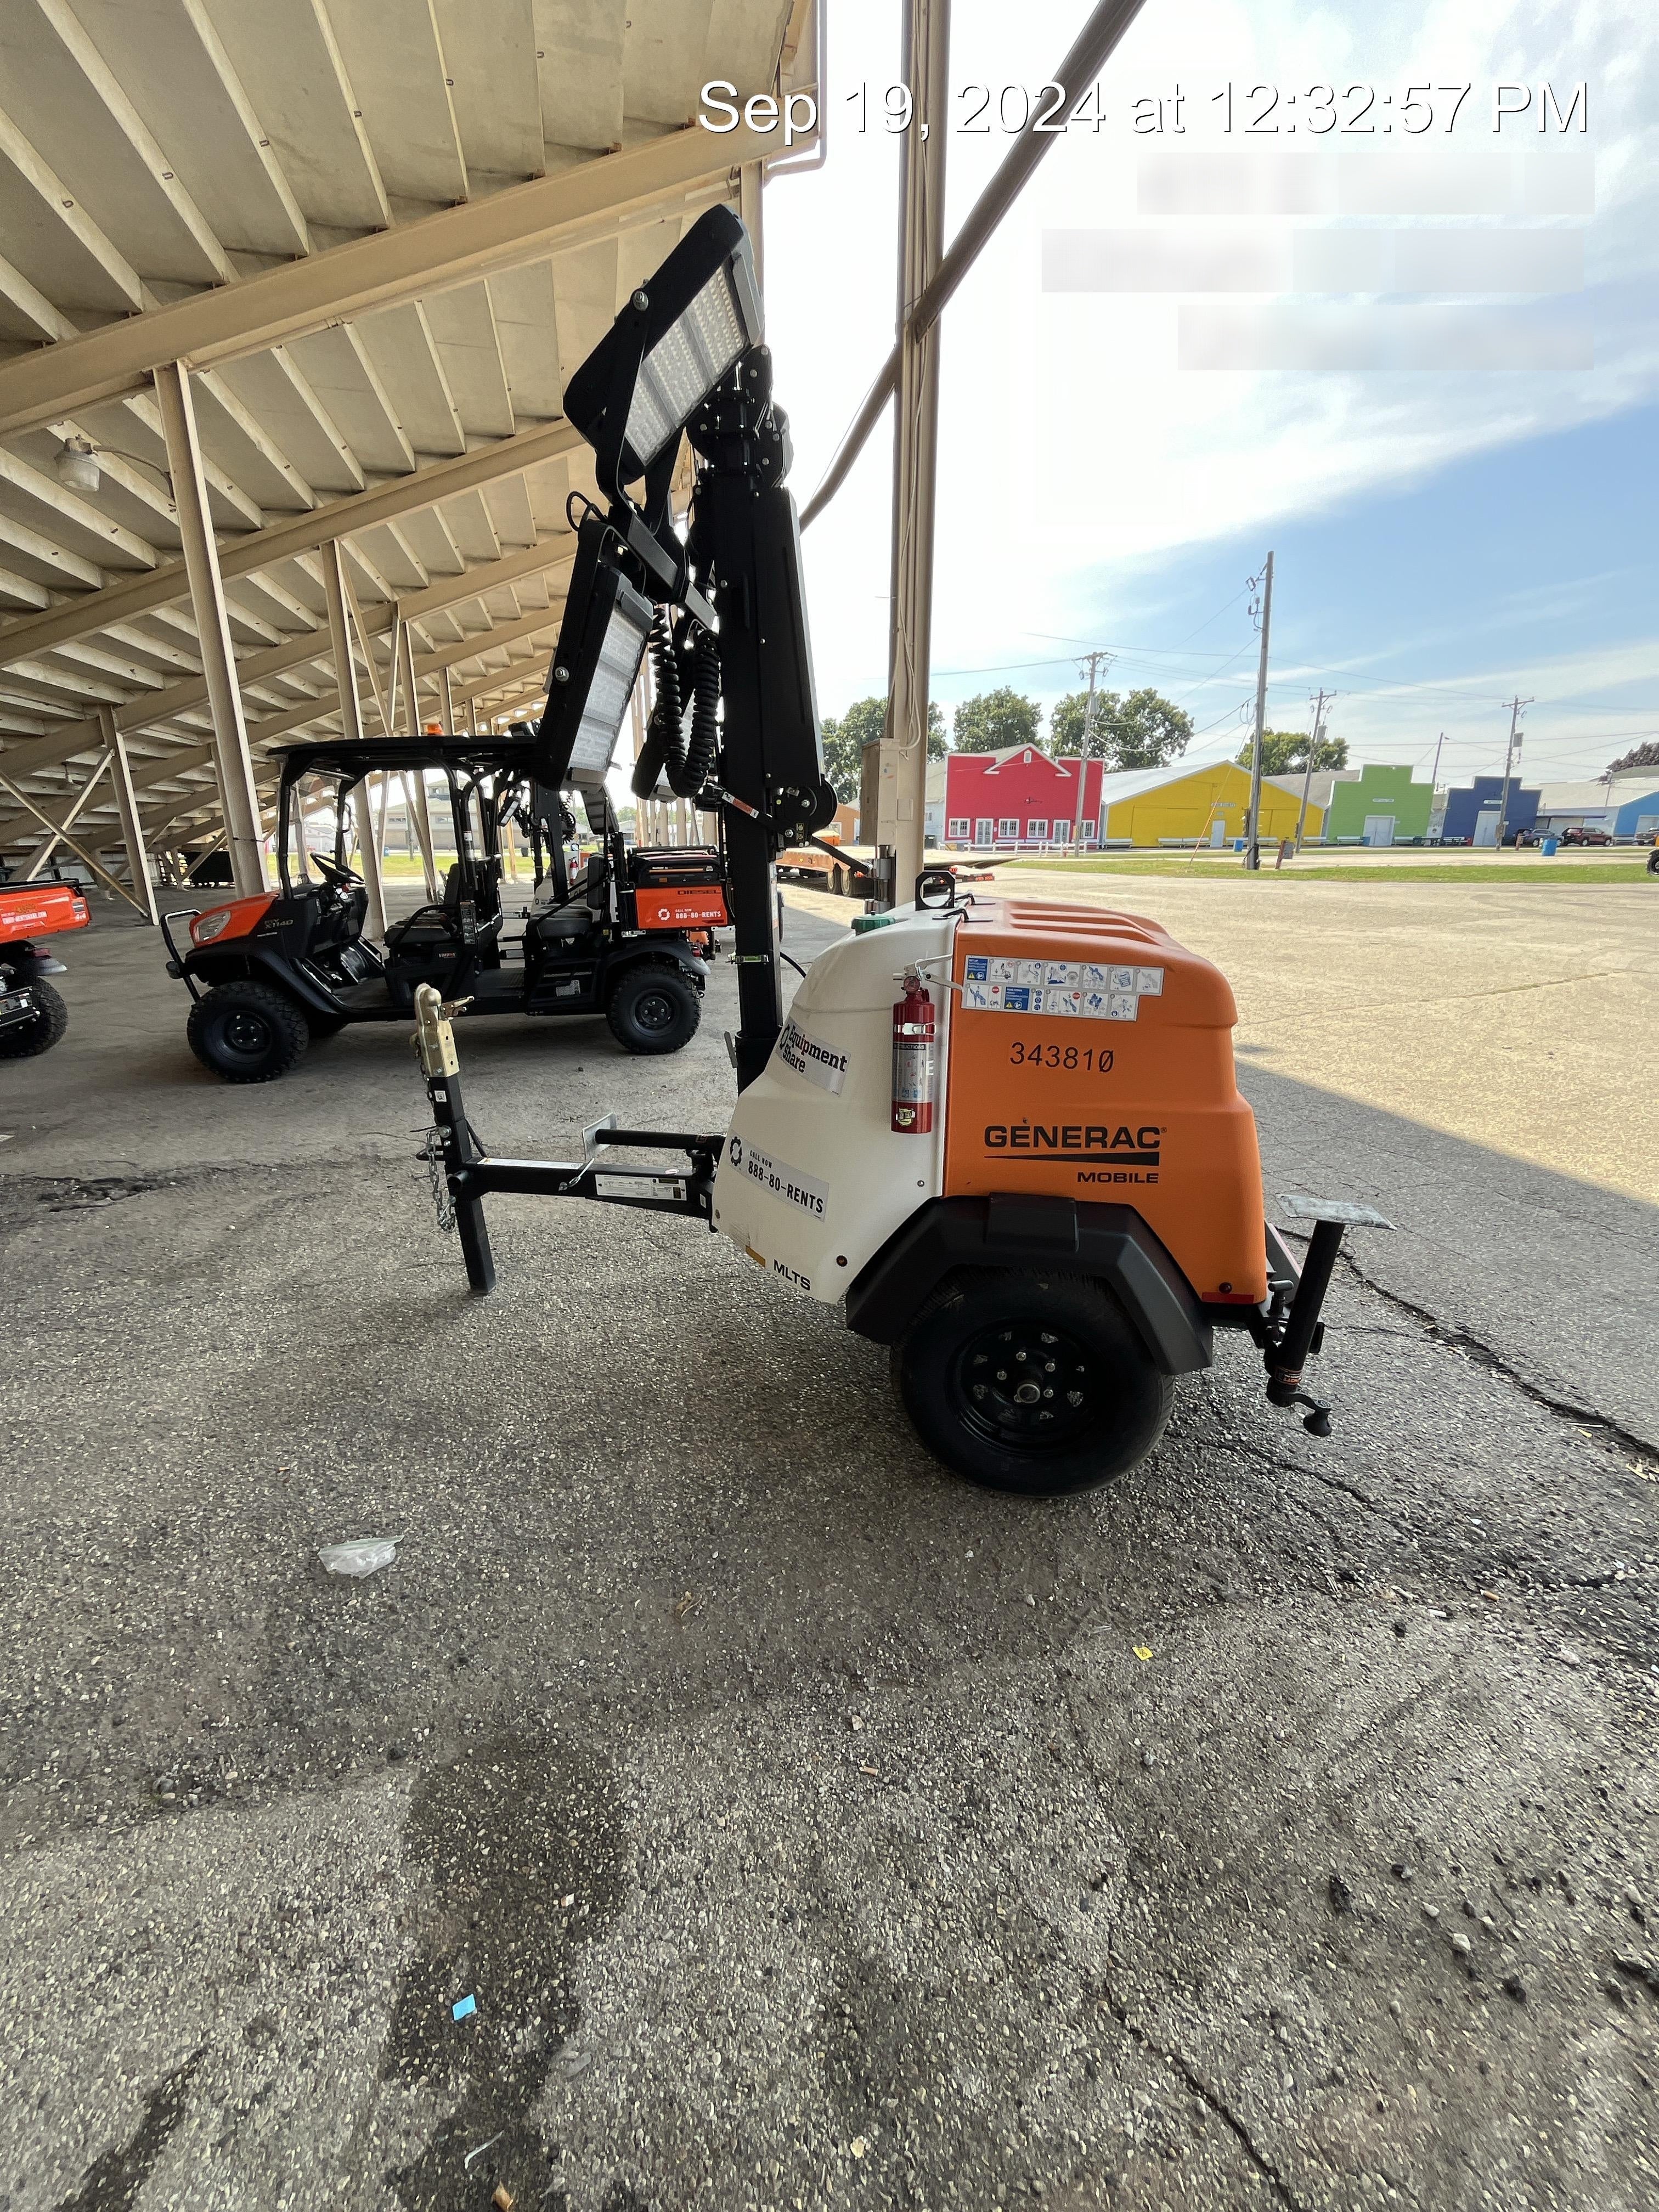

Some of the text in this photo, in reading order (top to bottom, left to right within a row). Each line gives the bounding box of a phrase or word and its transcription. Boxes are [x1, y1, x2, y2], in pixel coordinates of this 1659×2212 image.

[675, 911, 721, 919] 888-80-RENTS
[782, 1043, 806, 1073] Share
[788, 1025, 848, 1073] Equipment
[1009, 1042, 1114, 1073] 343810
[984, 1126, 1160, 1148] GENERAC
[750, 1150, 772, 1169] CALL NOW
[748, 1160, 823, 1213] 888-80-RENTS
[1076, 1171, 1159, 1183] MOBILE
[774, 1259, 811, 1291] MLTS
